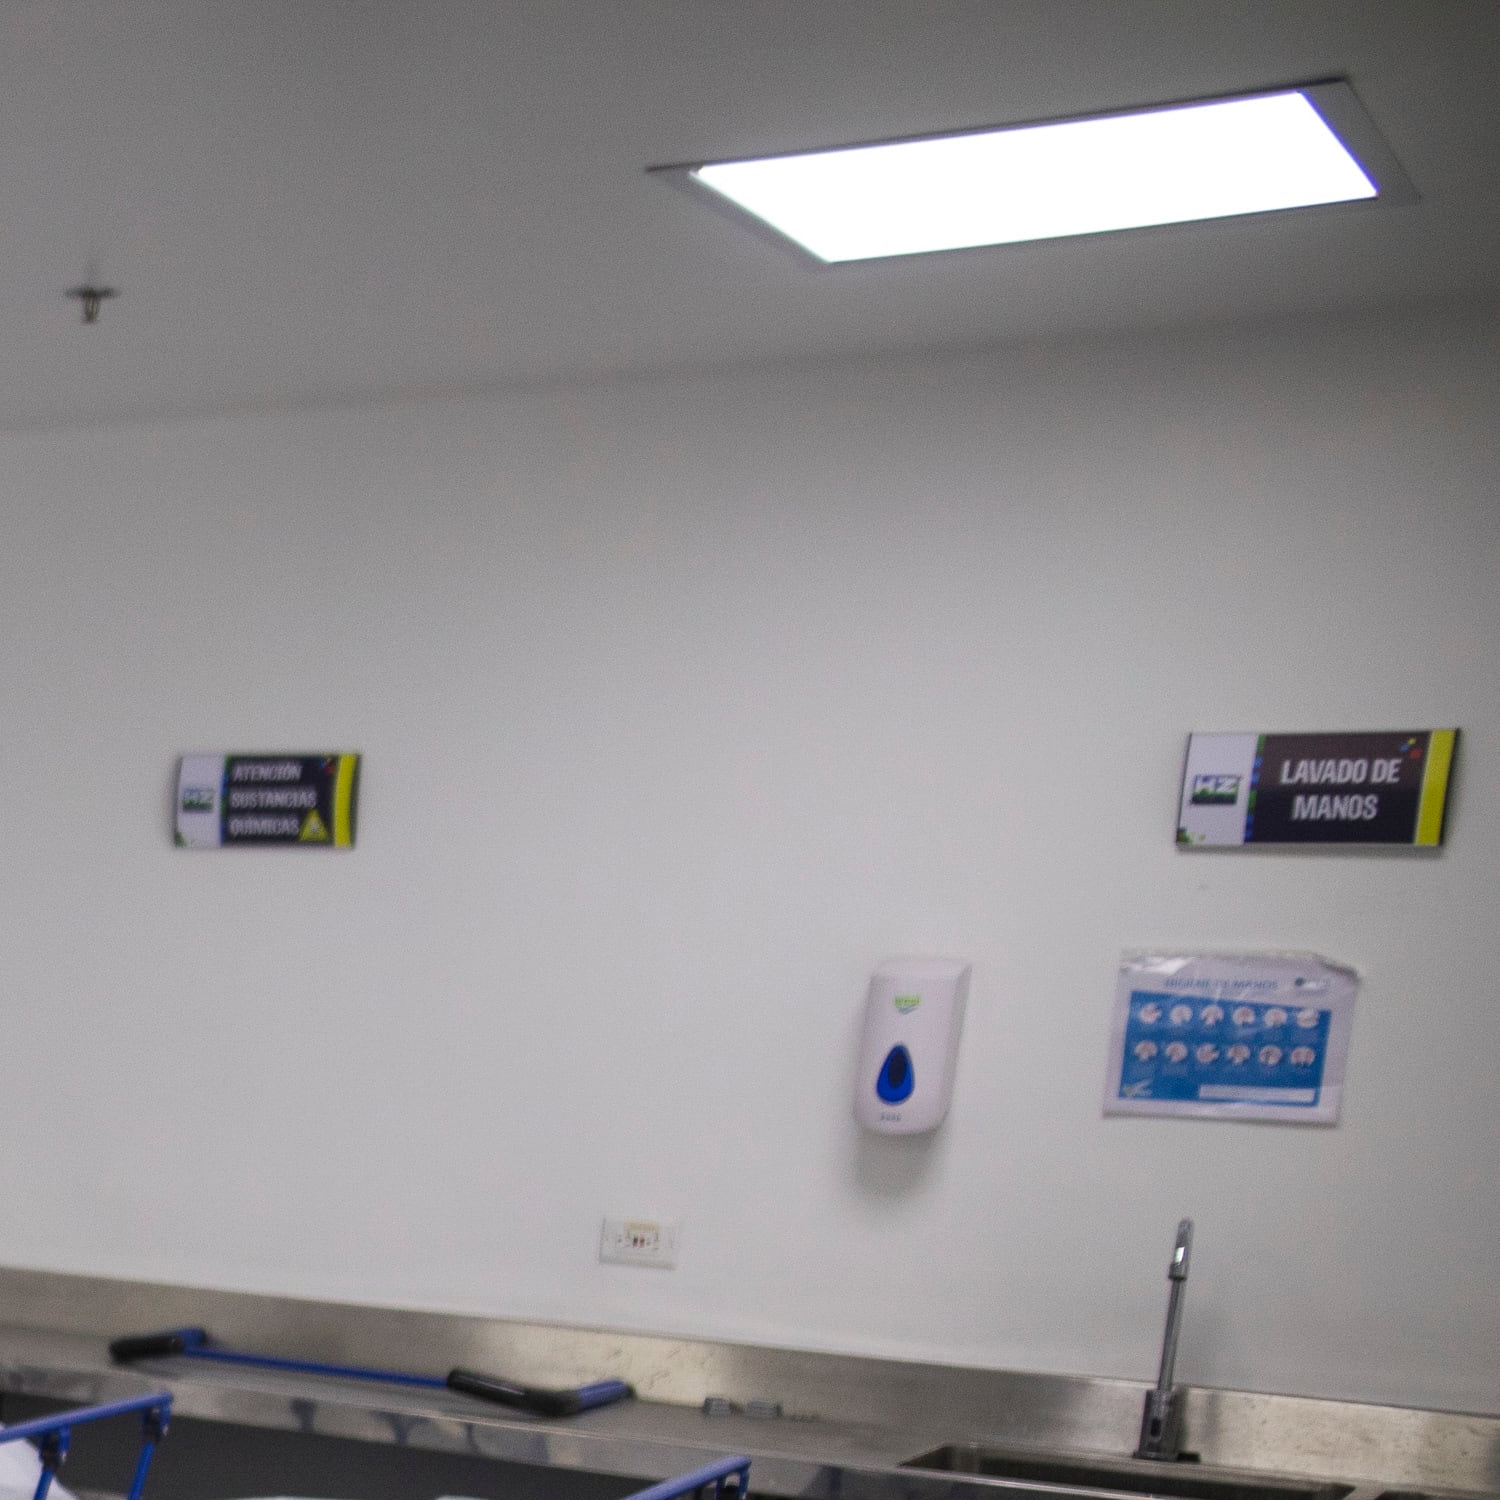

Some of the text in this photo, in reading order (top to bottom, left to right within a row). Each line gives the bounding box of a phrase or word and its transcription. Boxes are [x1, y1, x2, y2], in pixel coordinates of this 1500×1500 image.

[1281, 758, 1402, 784] LAVADO DE
[231, 789, 317, 809] SUSTANCIAS
[1293, 794, 1379, 820] MANOS
